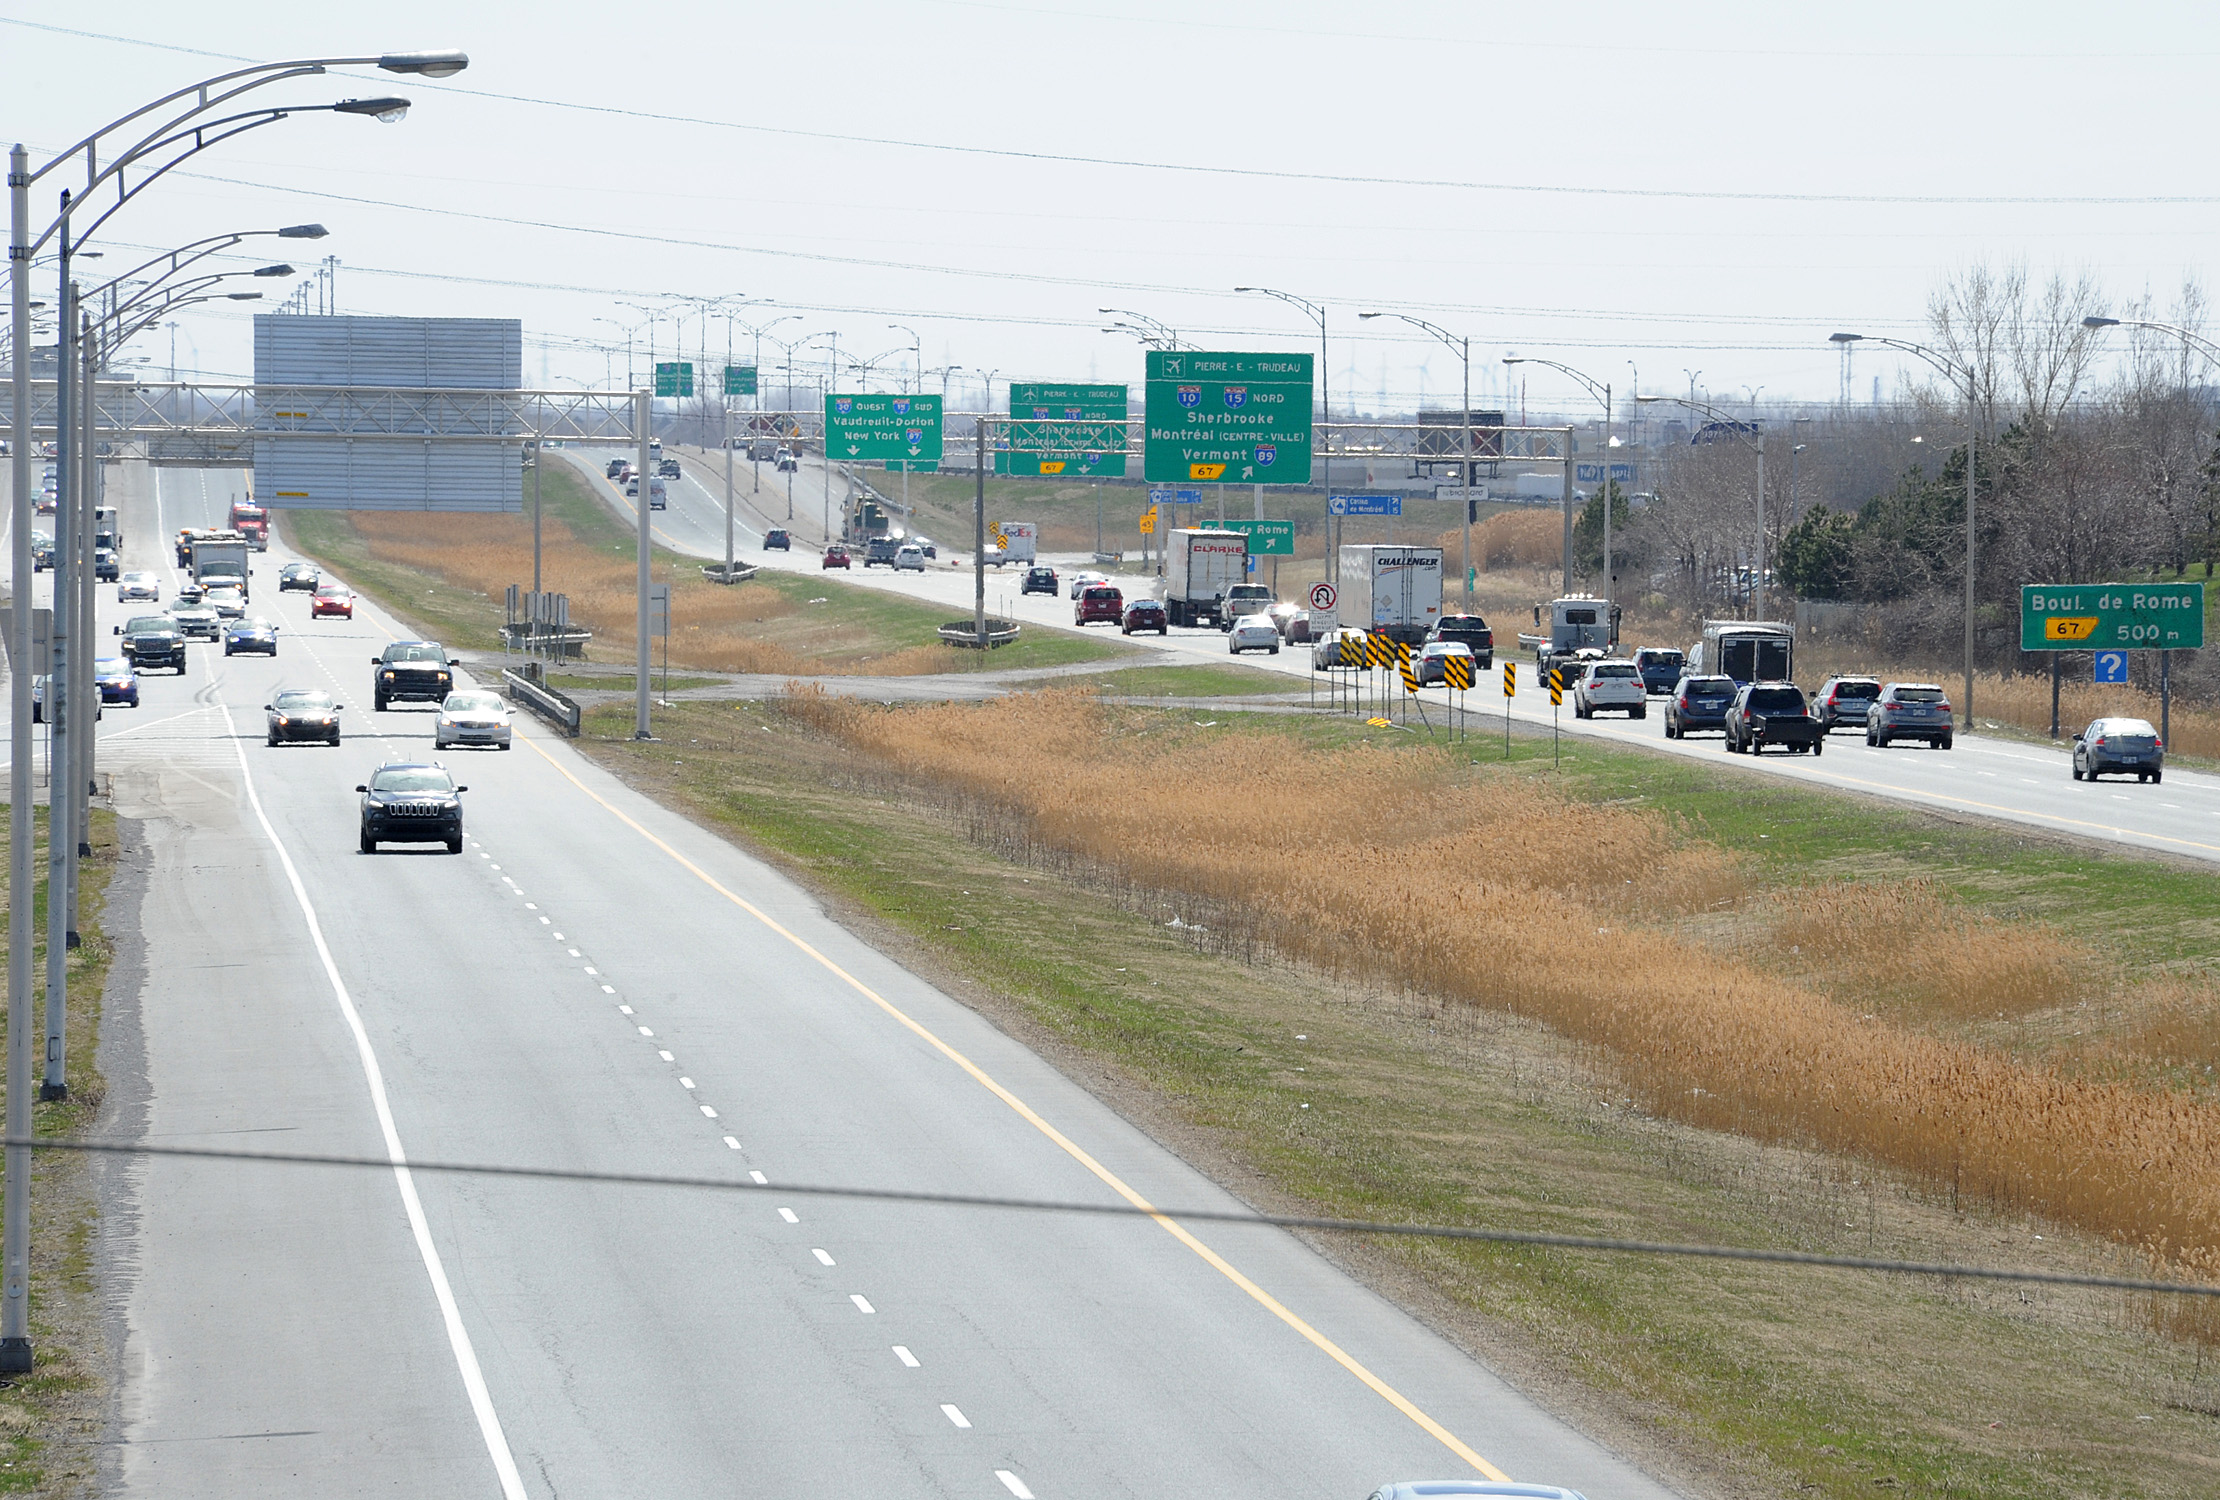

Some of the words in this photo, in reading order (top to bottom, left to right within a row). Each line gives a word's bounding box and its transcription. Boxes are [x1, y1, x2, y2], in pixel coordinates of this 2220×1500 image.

[1194, 361, 1228, 371] PIERRE
[1257, 362, 1301, 373] TRUDEAU
[1182, 393, 1196, 403] 10
[1228, 394, 1242, 403] 15
[1253, 393, 1285, 403] NORD
[914, 403, 933, 411] SUD
[833, 416, 934, 426] Vaudreuil-Dorion
[1187, 412, 1274, 424] Sherbrooke
[844, 431, 869, 440] New
[874, 431, 900, 440] York
[1151, 428, 1214, 441] Montréal
[1183, 449, 1247, 460] Vermont
[1258, 451, 1272, 461] 89
[1197, 467, 1213, 476] 67
[1003, 527, 1032, 538] FedEx
[1257, 525, 1289, 535] Rome
[1193, 545, 1244, 554] CLARKE
[1378, 557, 1439, 566] CHALLENGER
[2032, 595, 2085, 611] Boul.
[2098, 593, 2123, 609] de
[2133, 593, 2193, 609] Rome
[2056, 622, 2080, 635] 67
[2117, 624, 2160, 640] 500
[2167, 630, 2179, 640] m
